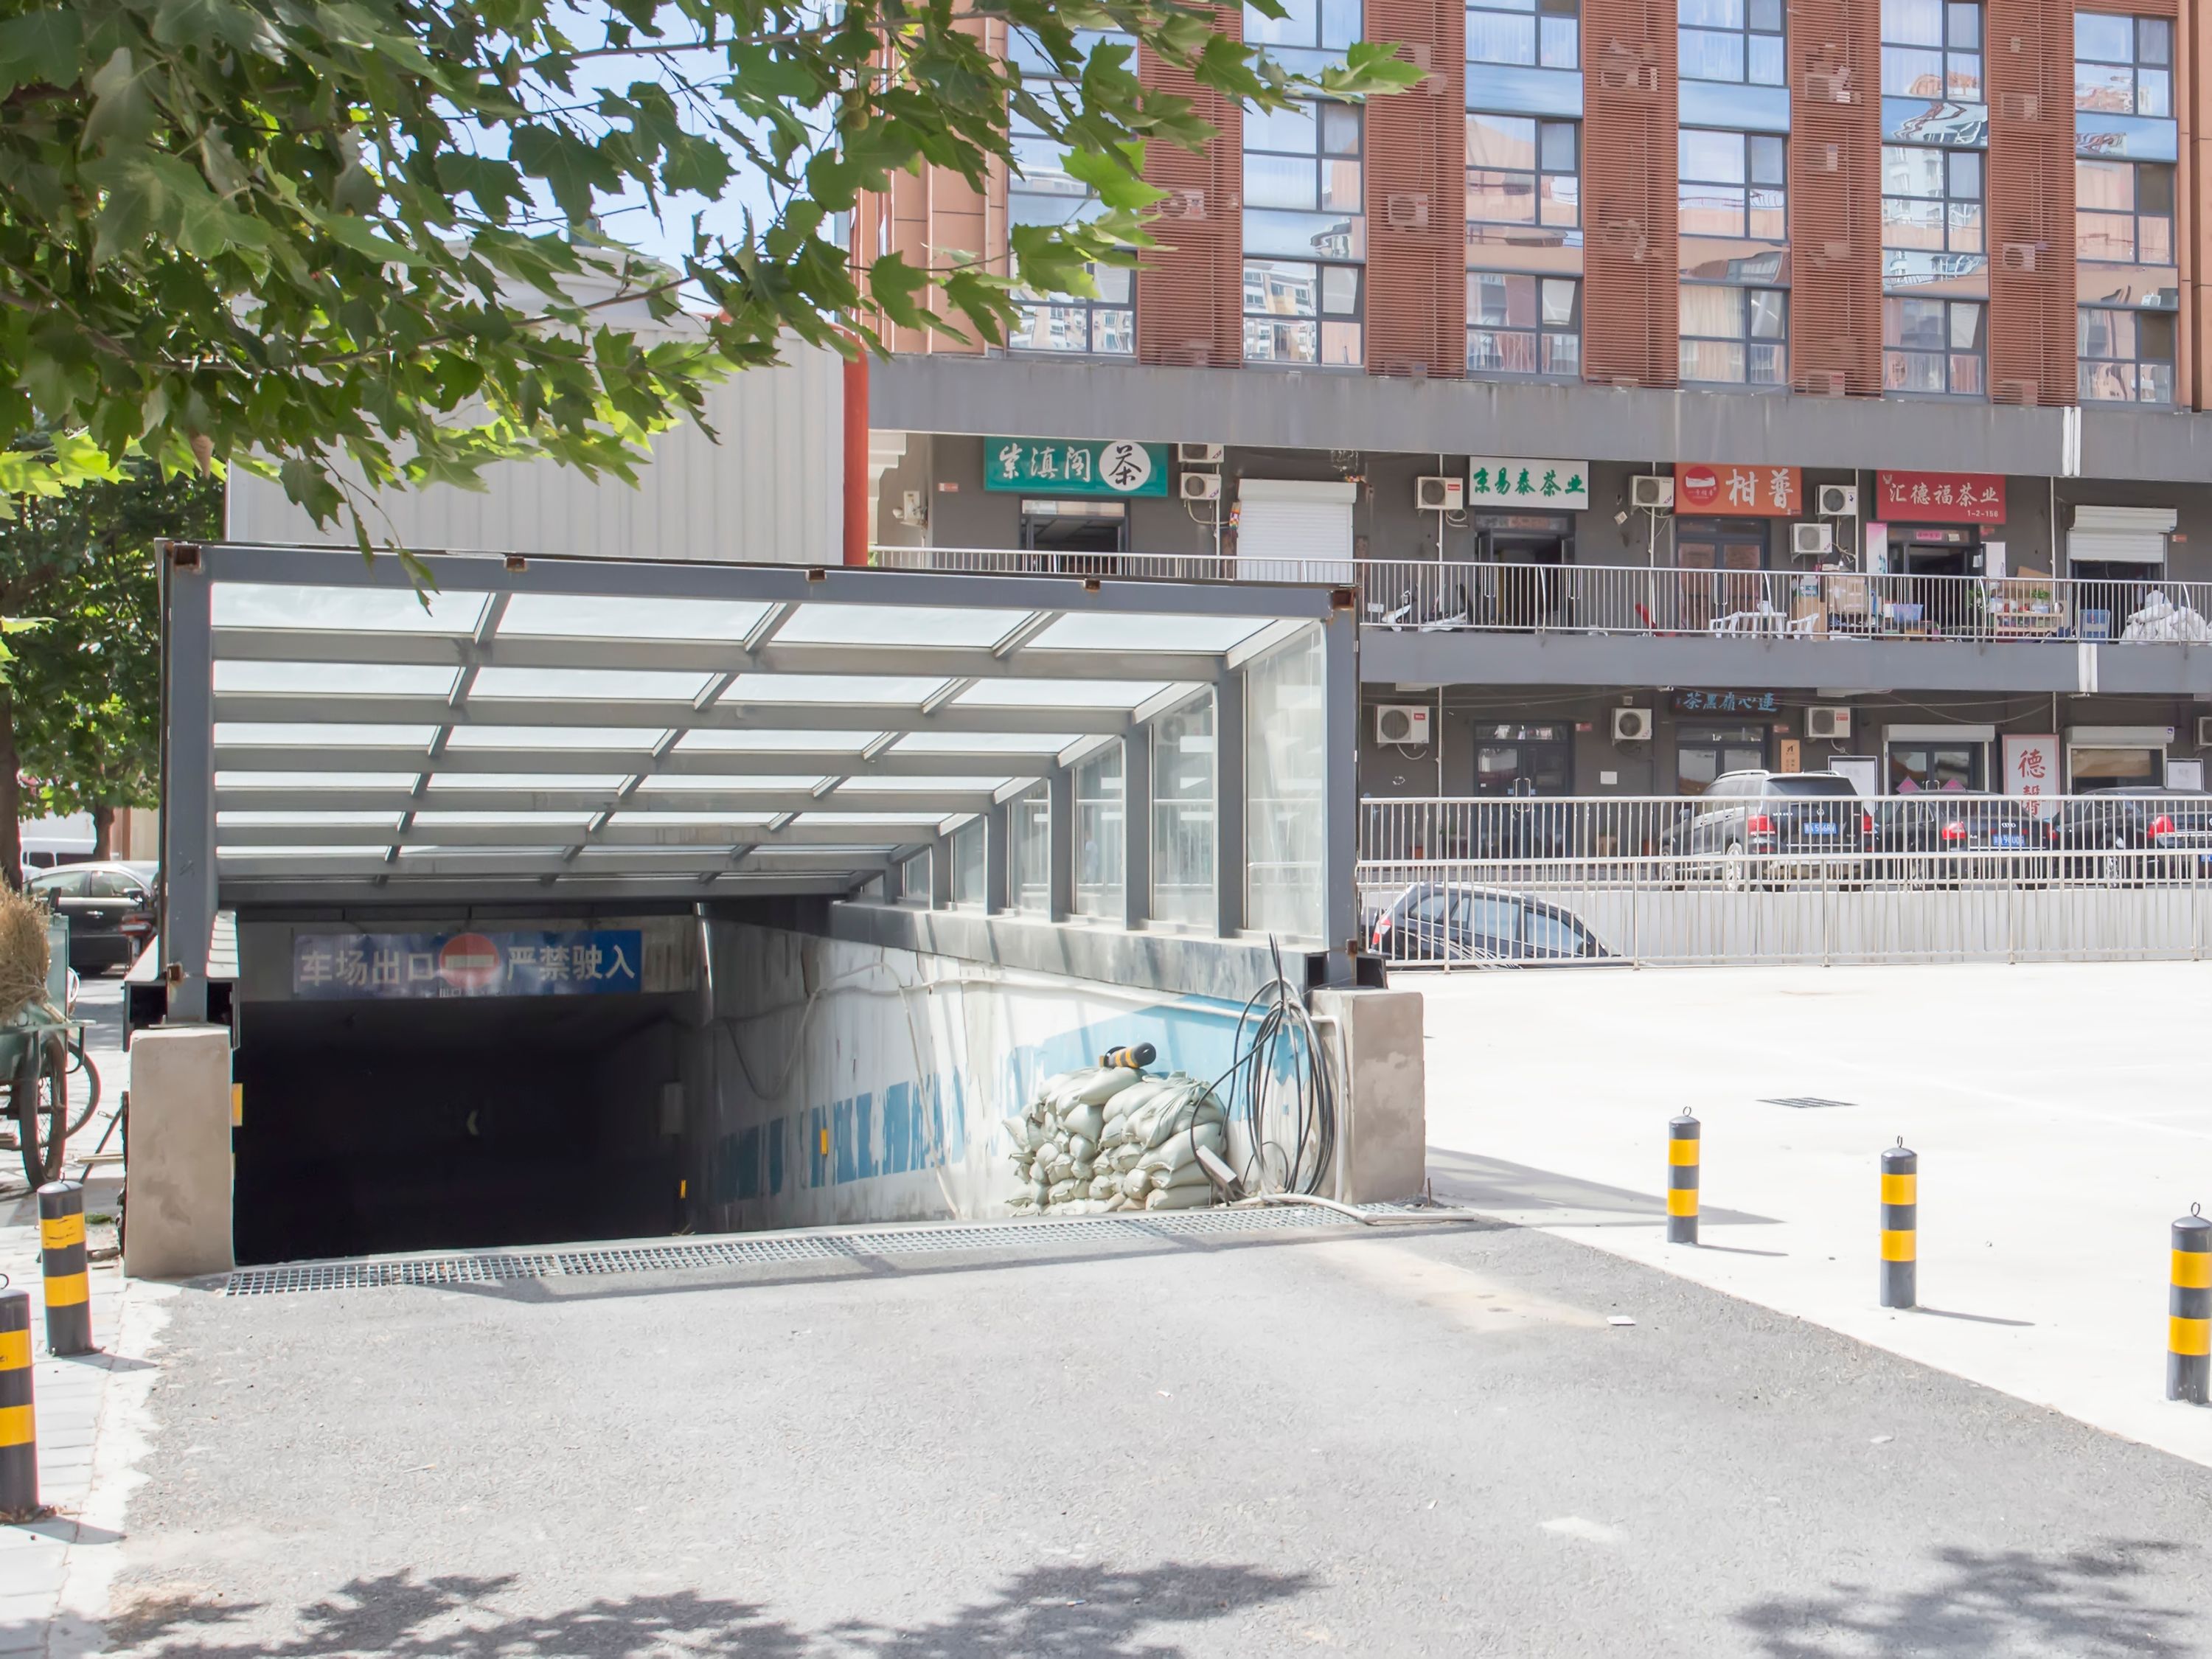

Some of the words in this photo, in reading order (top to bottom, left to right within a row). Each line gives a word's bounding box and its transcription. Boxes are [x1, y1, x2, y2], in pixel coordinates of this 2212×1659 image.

[1108, 445, 1142, 486] 茶
[1725, 468, 1794, 509] 柑普
[1890, 481, 2000, 507] 汇德福茶业
[300, 948, 434, 987] 车场出口
[507, 944, 636, 982] 严禁驶入
